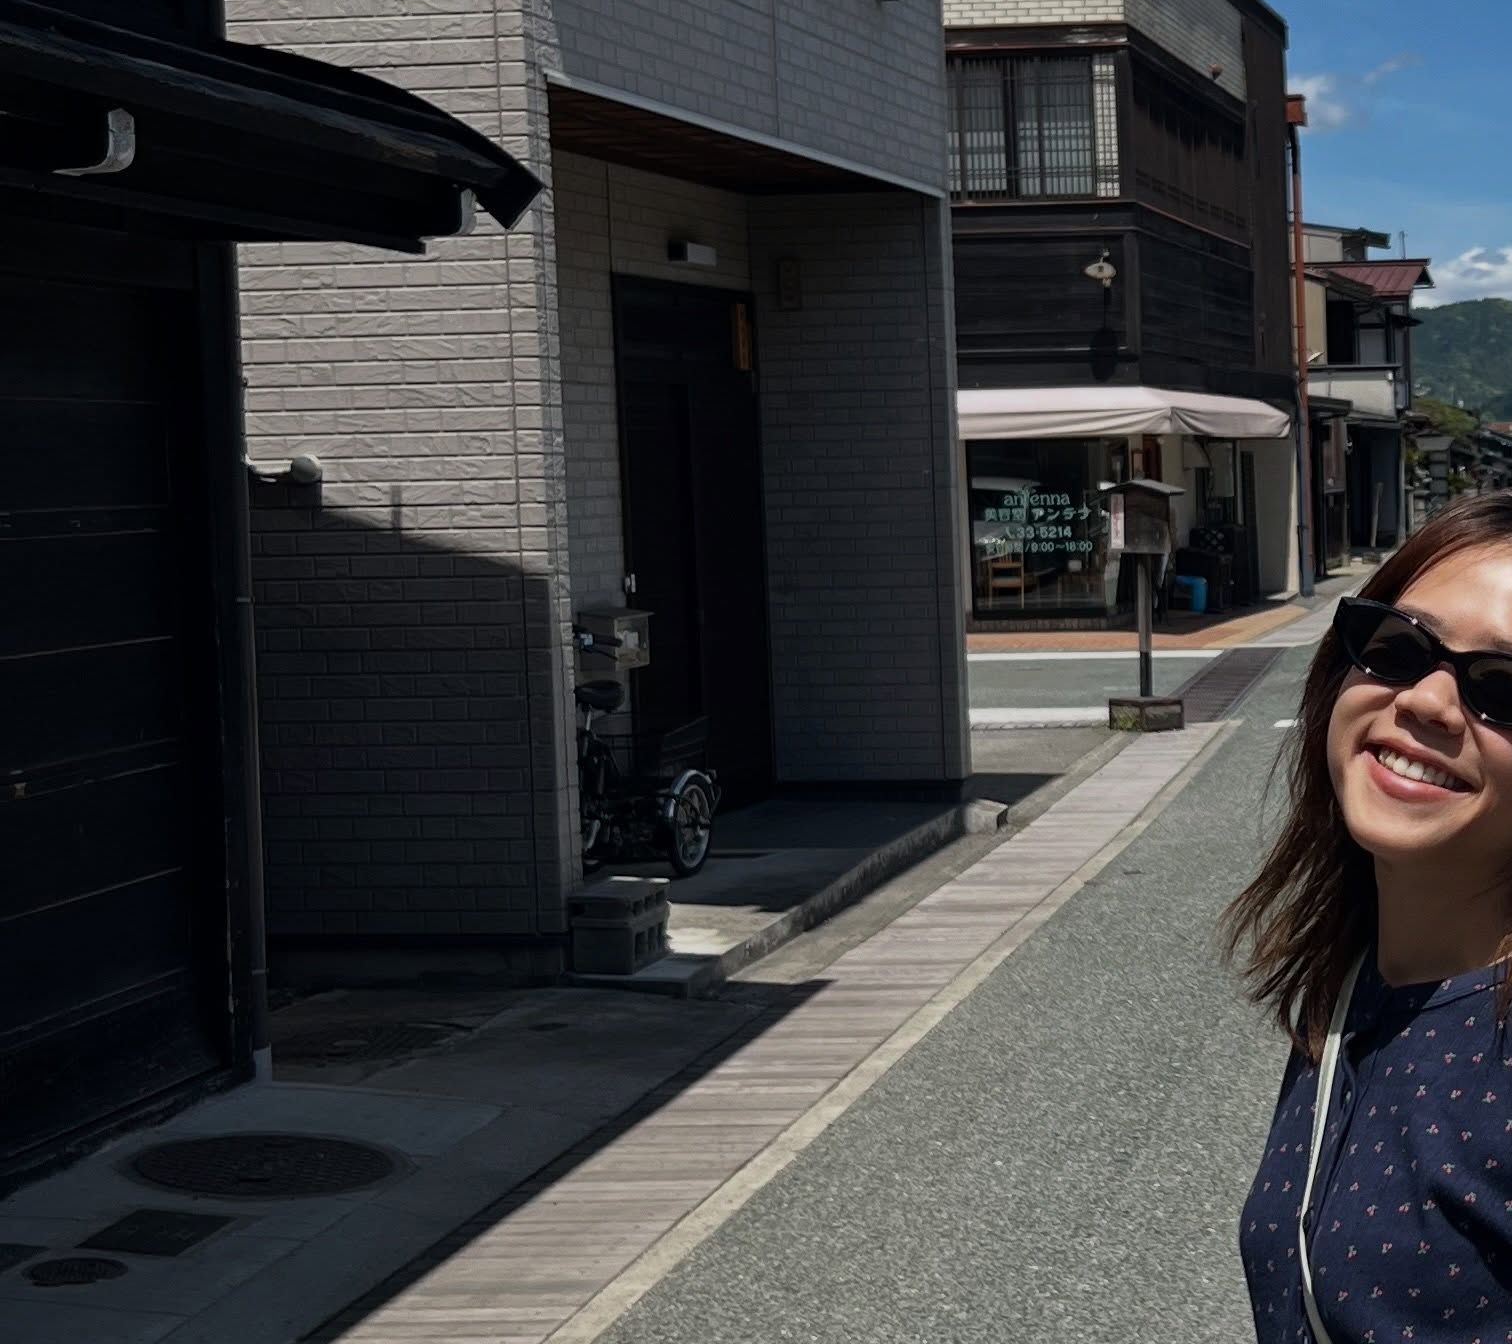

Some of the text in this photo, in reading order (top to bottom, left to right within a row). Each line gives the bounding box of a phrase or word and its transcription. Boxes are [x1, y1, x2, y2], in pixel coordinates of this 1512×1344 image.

[1004, 489, 1071, 506] antenna
[1032, 505, 1092, 521] アンテナ
